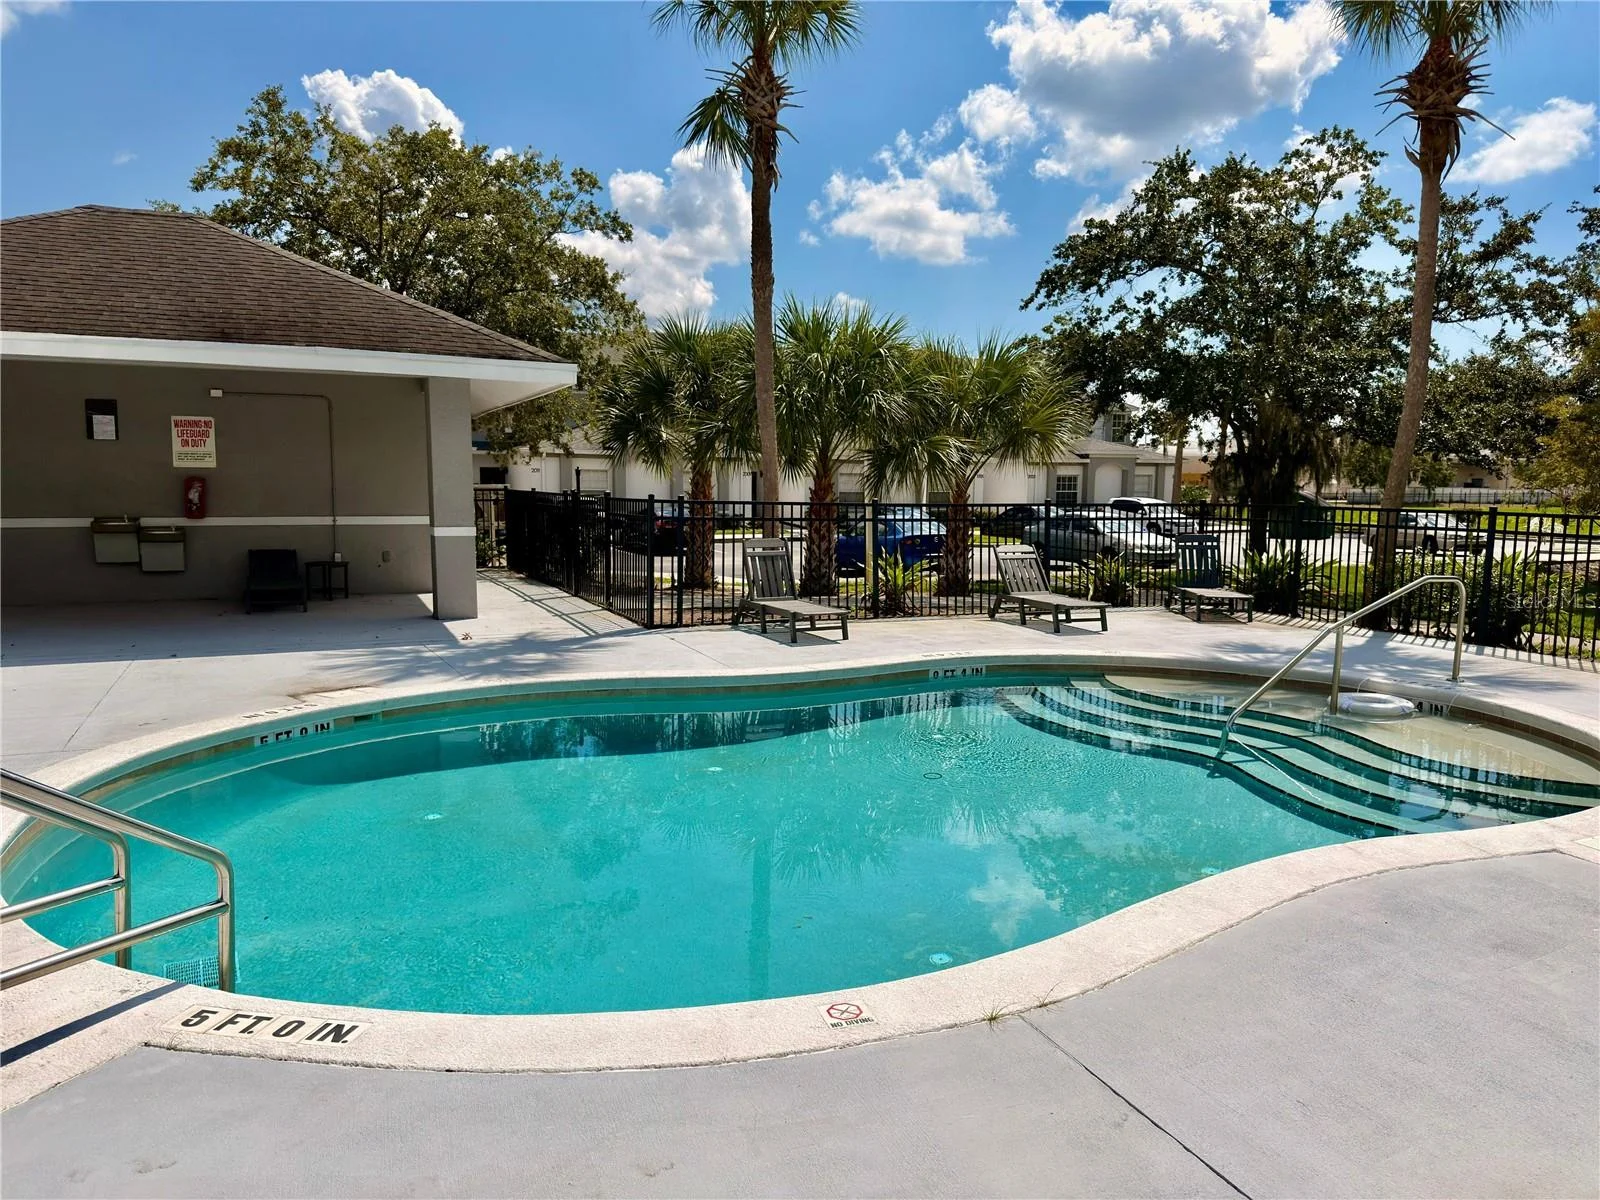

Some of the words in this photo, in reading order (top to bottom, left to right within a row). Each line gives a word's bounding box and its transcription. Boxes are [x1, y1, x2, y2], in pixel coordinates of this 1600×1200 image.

[176, 429, 210, 439] LIFEGUARD
[180, 438, 190, 448] ON
[190, 438, 207, 448] DUTY
[314, 722, 331, 734] IN
[180, 1009, 218, 1028] 5
[830, 1021, 844, 1029] NO
[845, 1017, 875, 1027] DIVING
